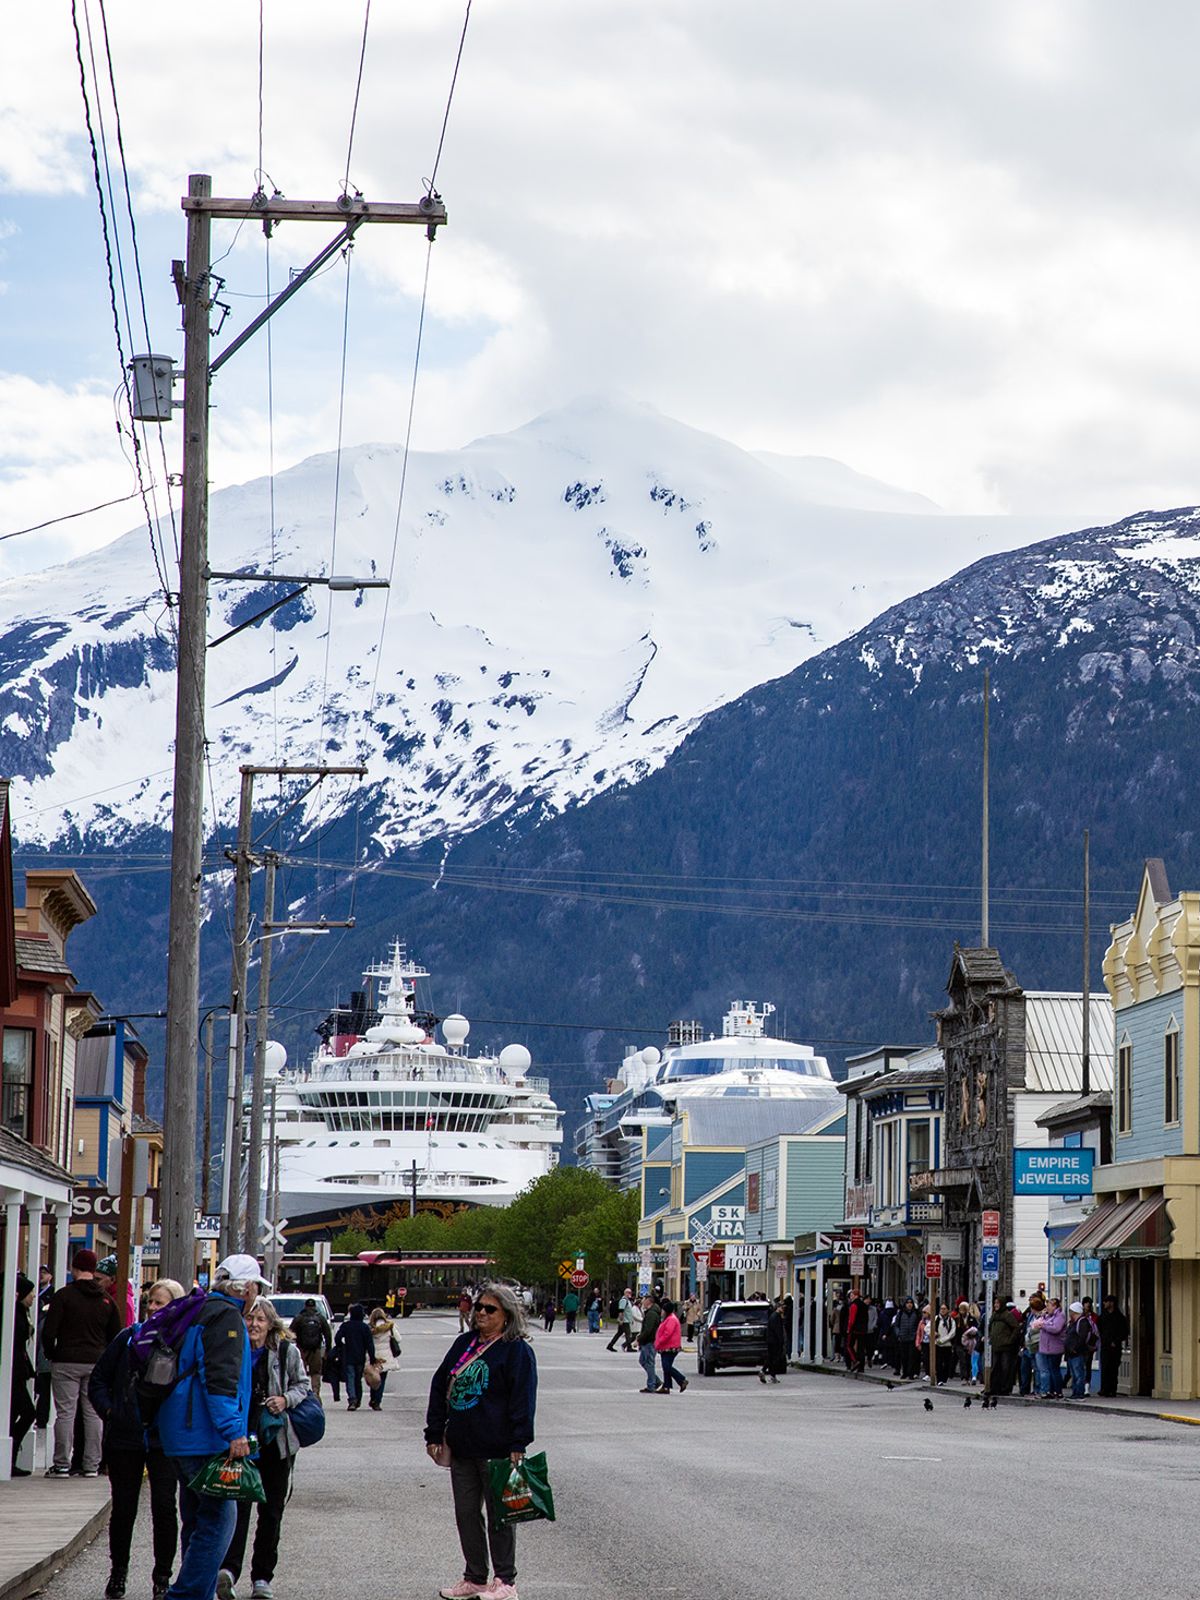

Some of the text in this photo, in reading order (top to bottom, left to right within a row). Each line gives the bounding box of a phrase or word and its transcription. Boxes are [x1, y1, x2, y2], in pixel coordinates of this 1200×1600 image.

[1028, 1157, 1080, 1169] EMPIRE
[1018, 1173, 1090, 1185] JEWELERS
[734, 1245, 758, 1257] THE
[838, 1242, 893, 1253] AUORA
[728, 1258, 762, 1270] LOOM
[572, 1275, 588, 1283] STOP
